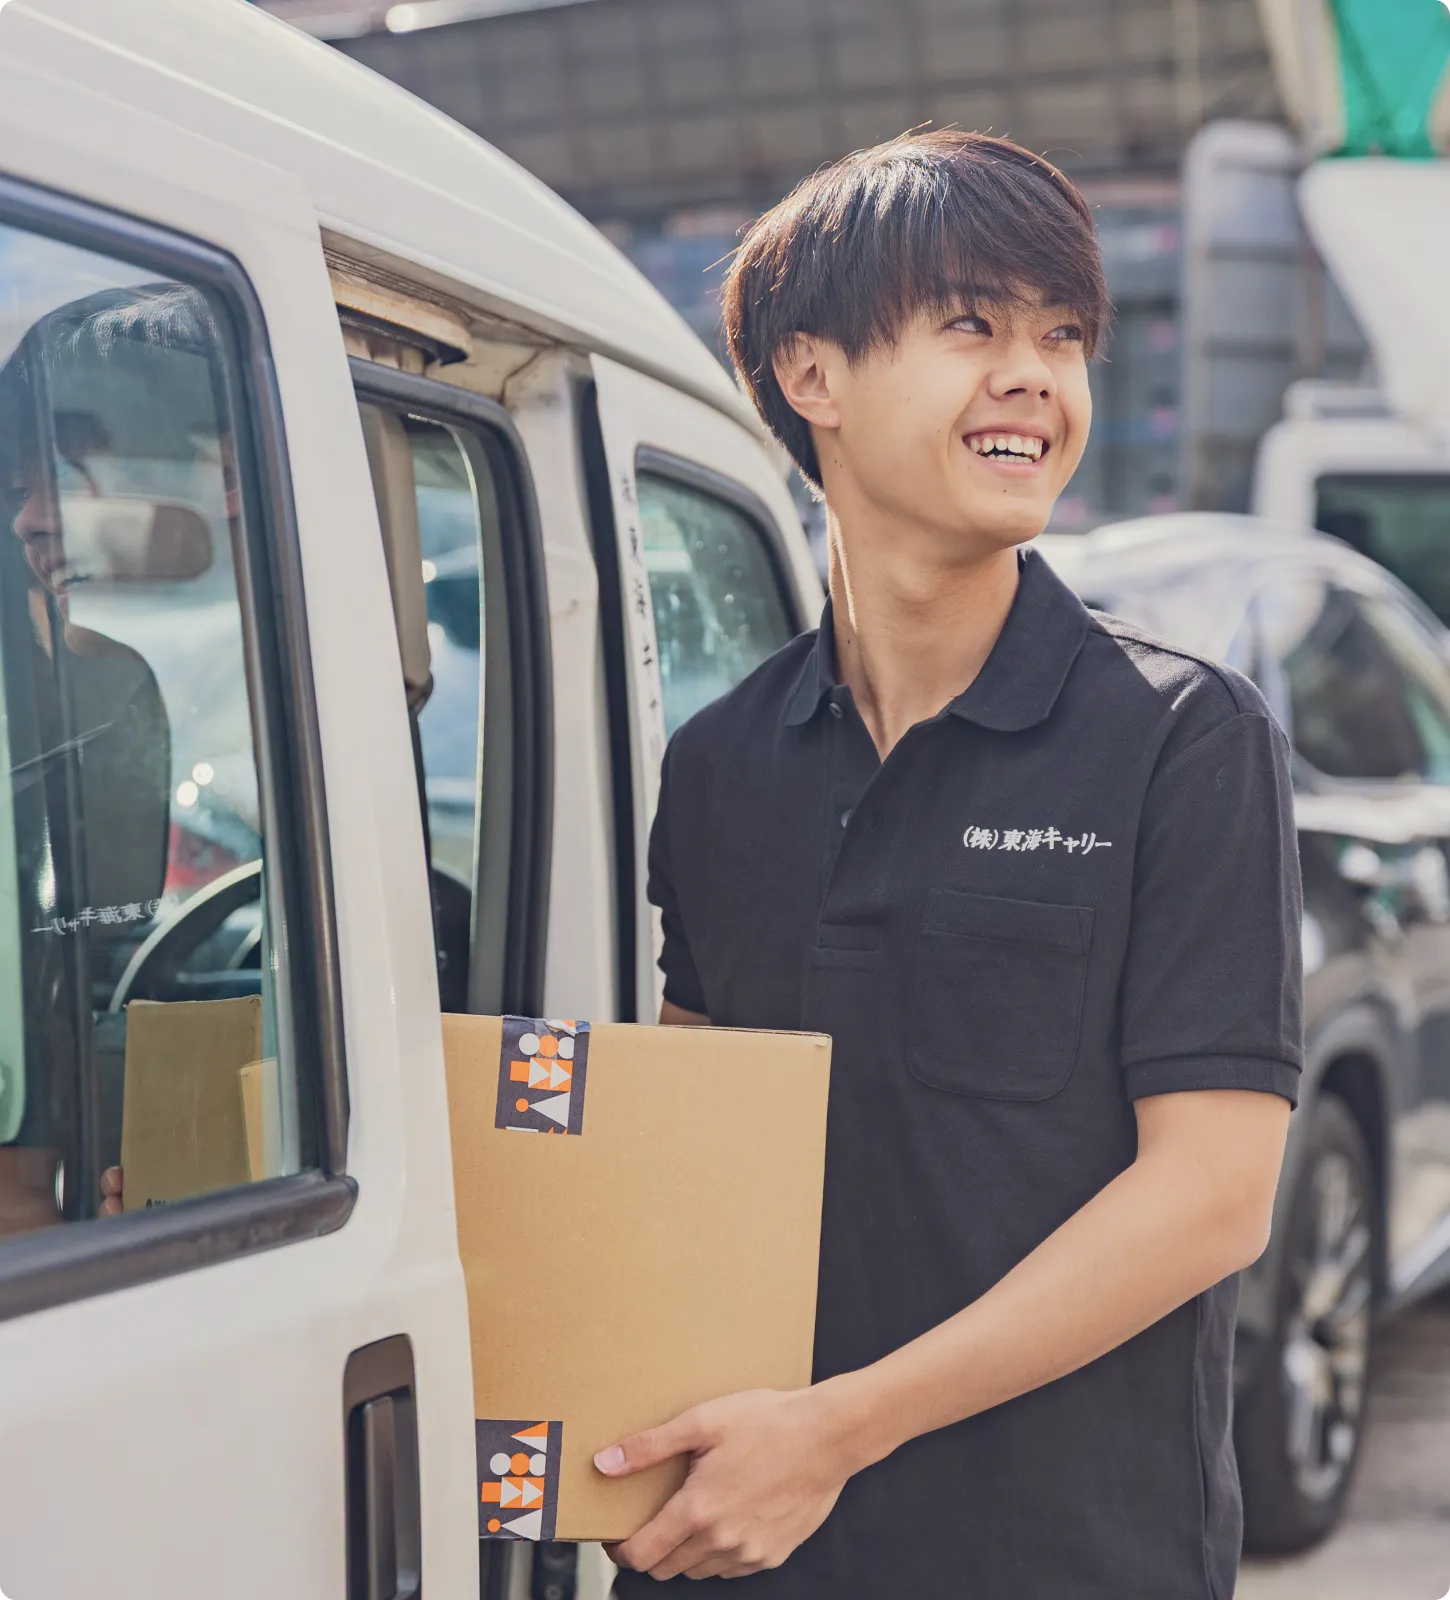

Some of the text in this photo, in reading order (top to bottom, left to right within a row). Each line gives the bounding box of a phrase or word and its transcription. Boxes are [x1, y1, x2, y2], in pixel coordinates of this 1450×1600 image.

[963, 826, 1113, 855] (株)東海キャリー
